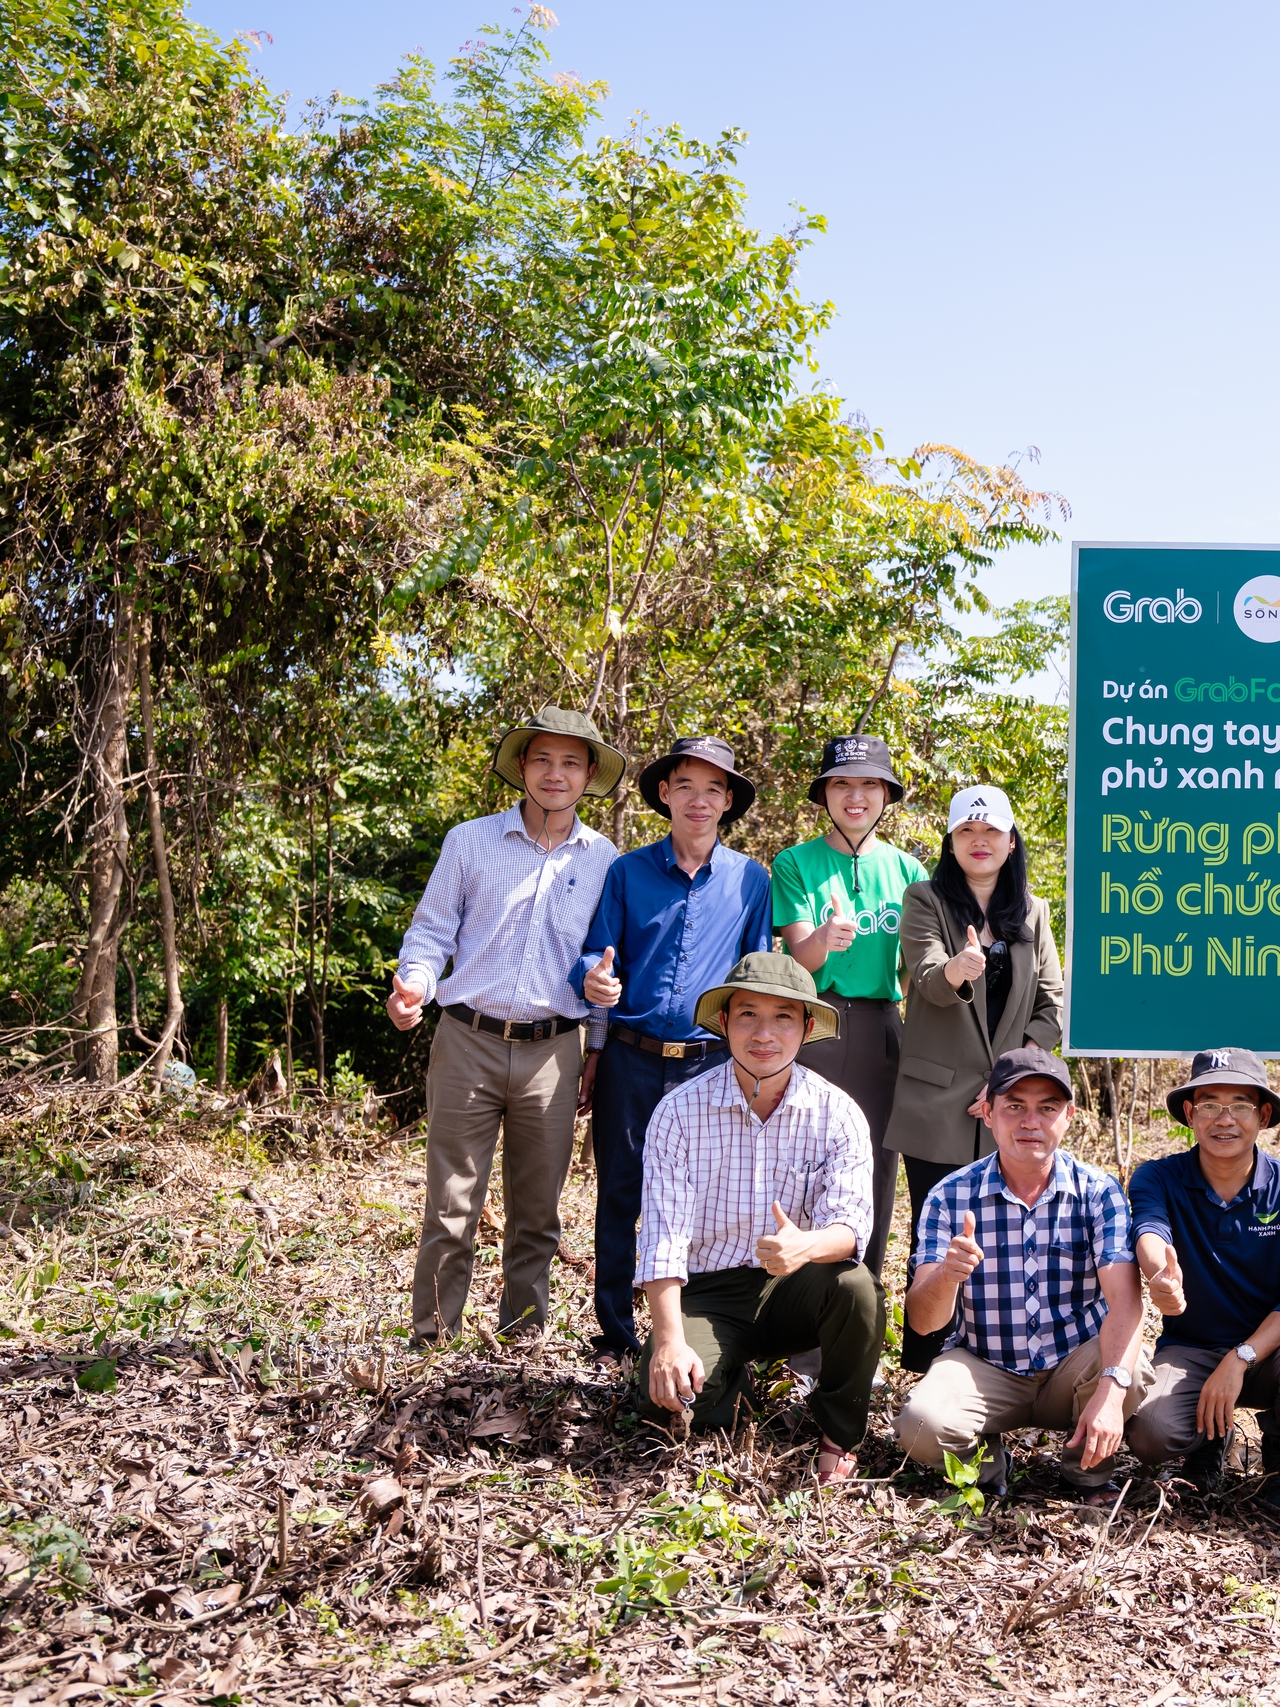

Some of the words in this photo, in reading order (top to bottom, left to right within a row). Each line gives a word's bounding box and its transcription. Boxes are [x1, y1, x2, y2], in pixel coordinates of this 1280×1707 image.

[1103, 588, 1203, 624] Grab
[1103, 680, 1136, 703] Dự
[1139, 679, 1168, 699] án
[1102, 716, 1214, 753] Chung
[1101, 757, 1168, 796] phủ
[1177, 760, 1264, 790] xanh
[1102, 810, 1230, 866] Rừng
[1101, 867, 1164, 915] hồ
[1101, 933, 1193, 977] Phú
